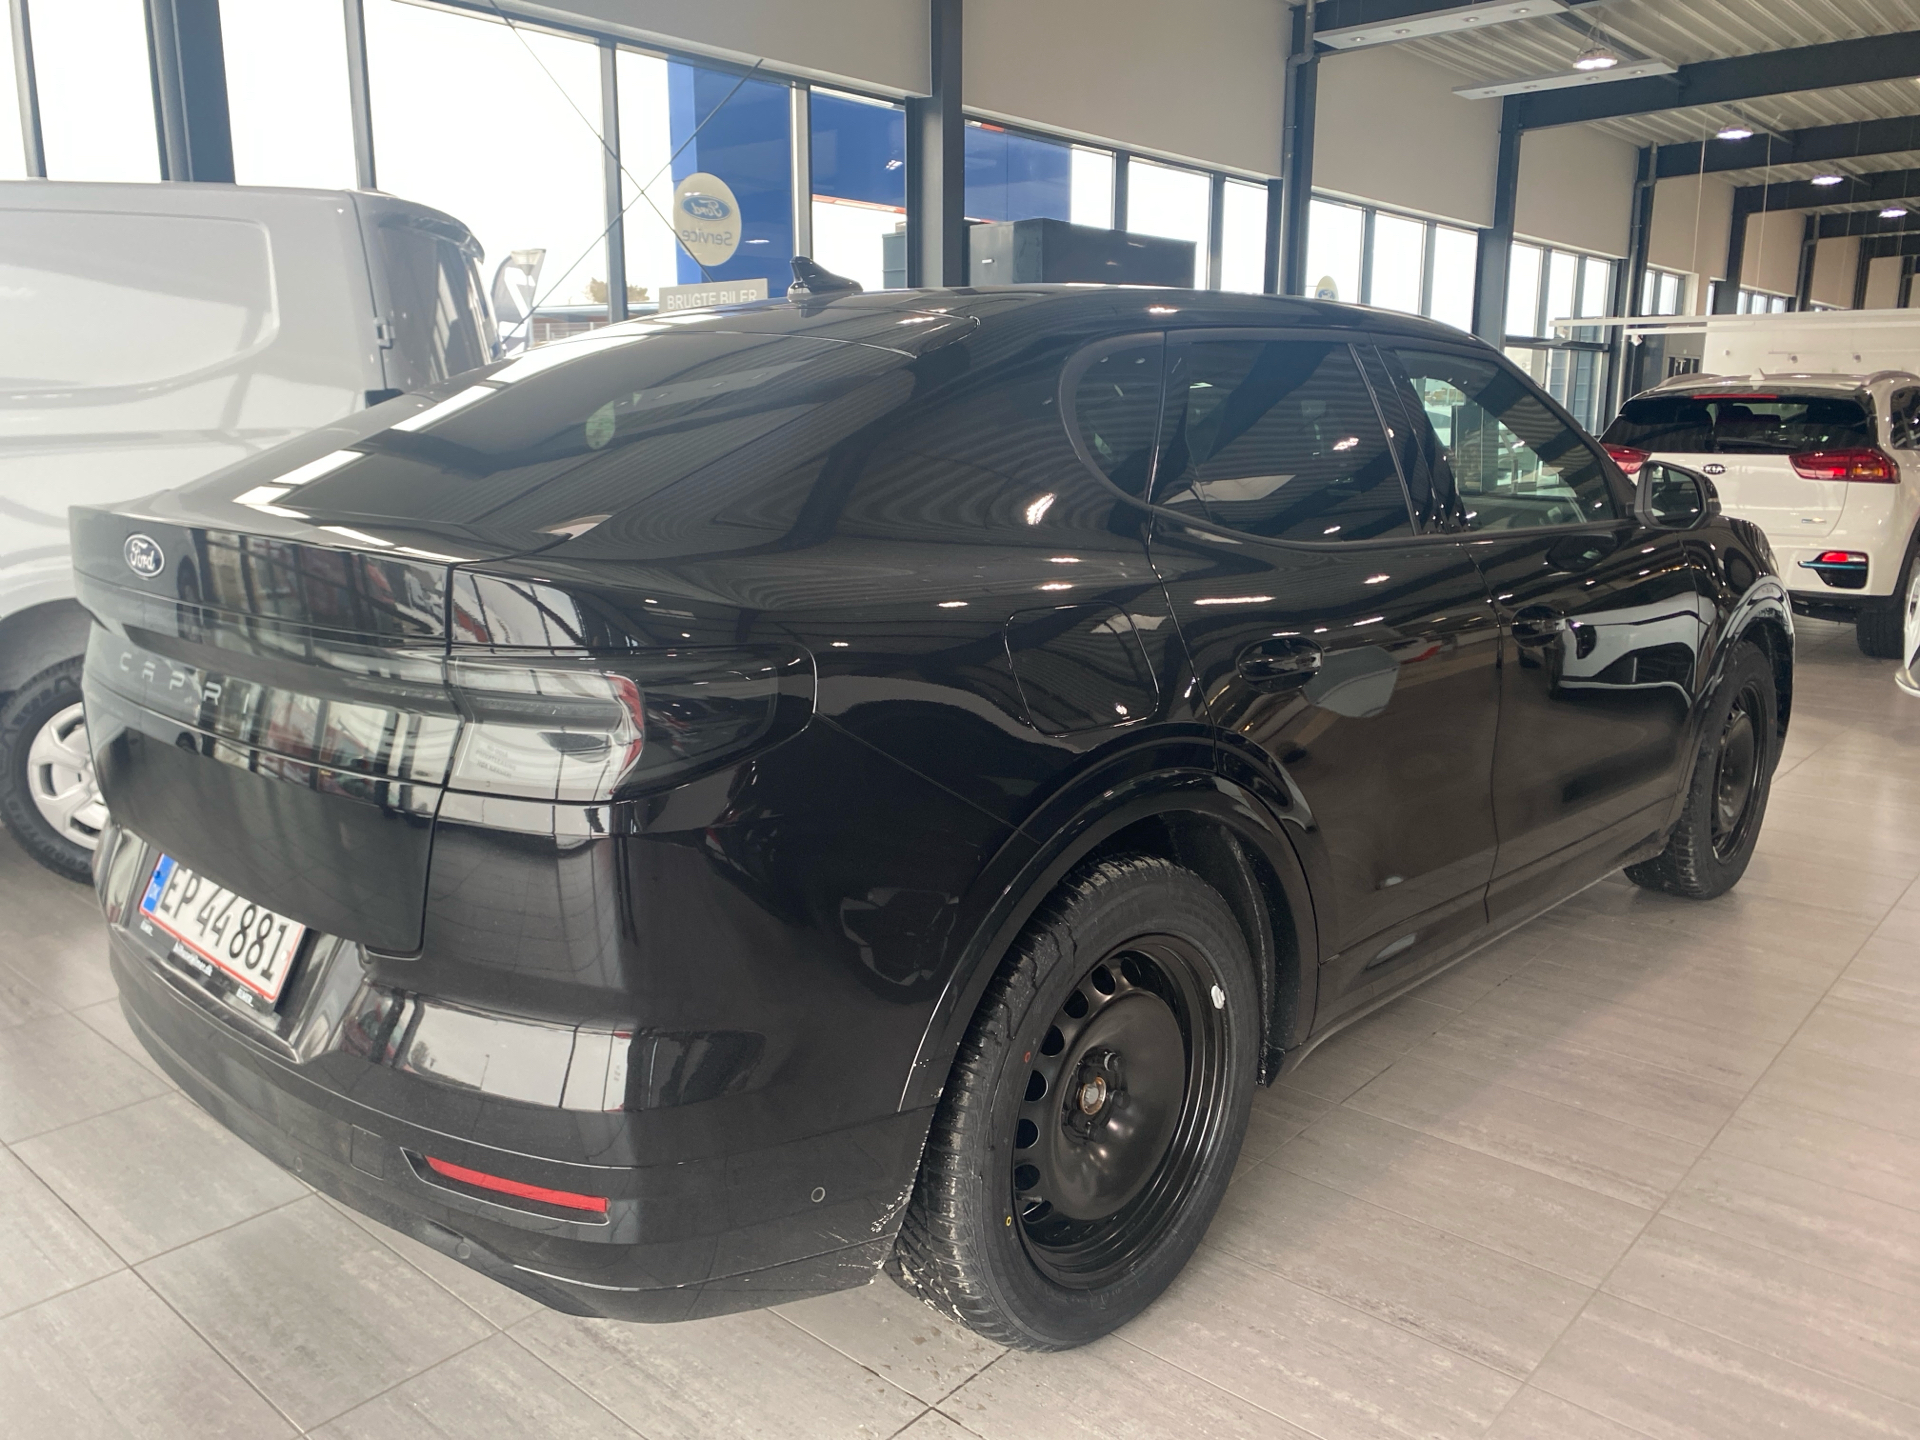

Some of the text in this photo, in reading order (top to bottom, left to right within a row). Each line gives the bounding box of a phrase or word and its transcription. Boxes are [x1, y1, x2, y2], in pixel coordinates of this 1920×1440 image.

[666, 291, 717, 310] BRUGTE
[129, 538, 157, 572] Ford
[119, 651, 250, 715] CAPRI
[160, 863, 202, 919] EP
[196, 887, 239, 948] 44
[229, 903, 291, 982] 881
